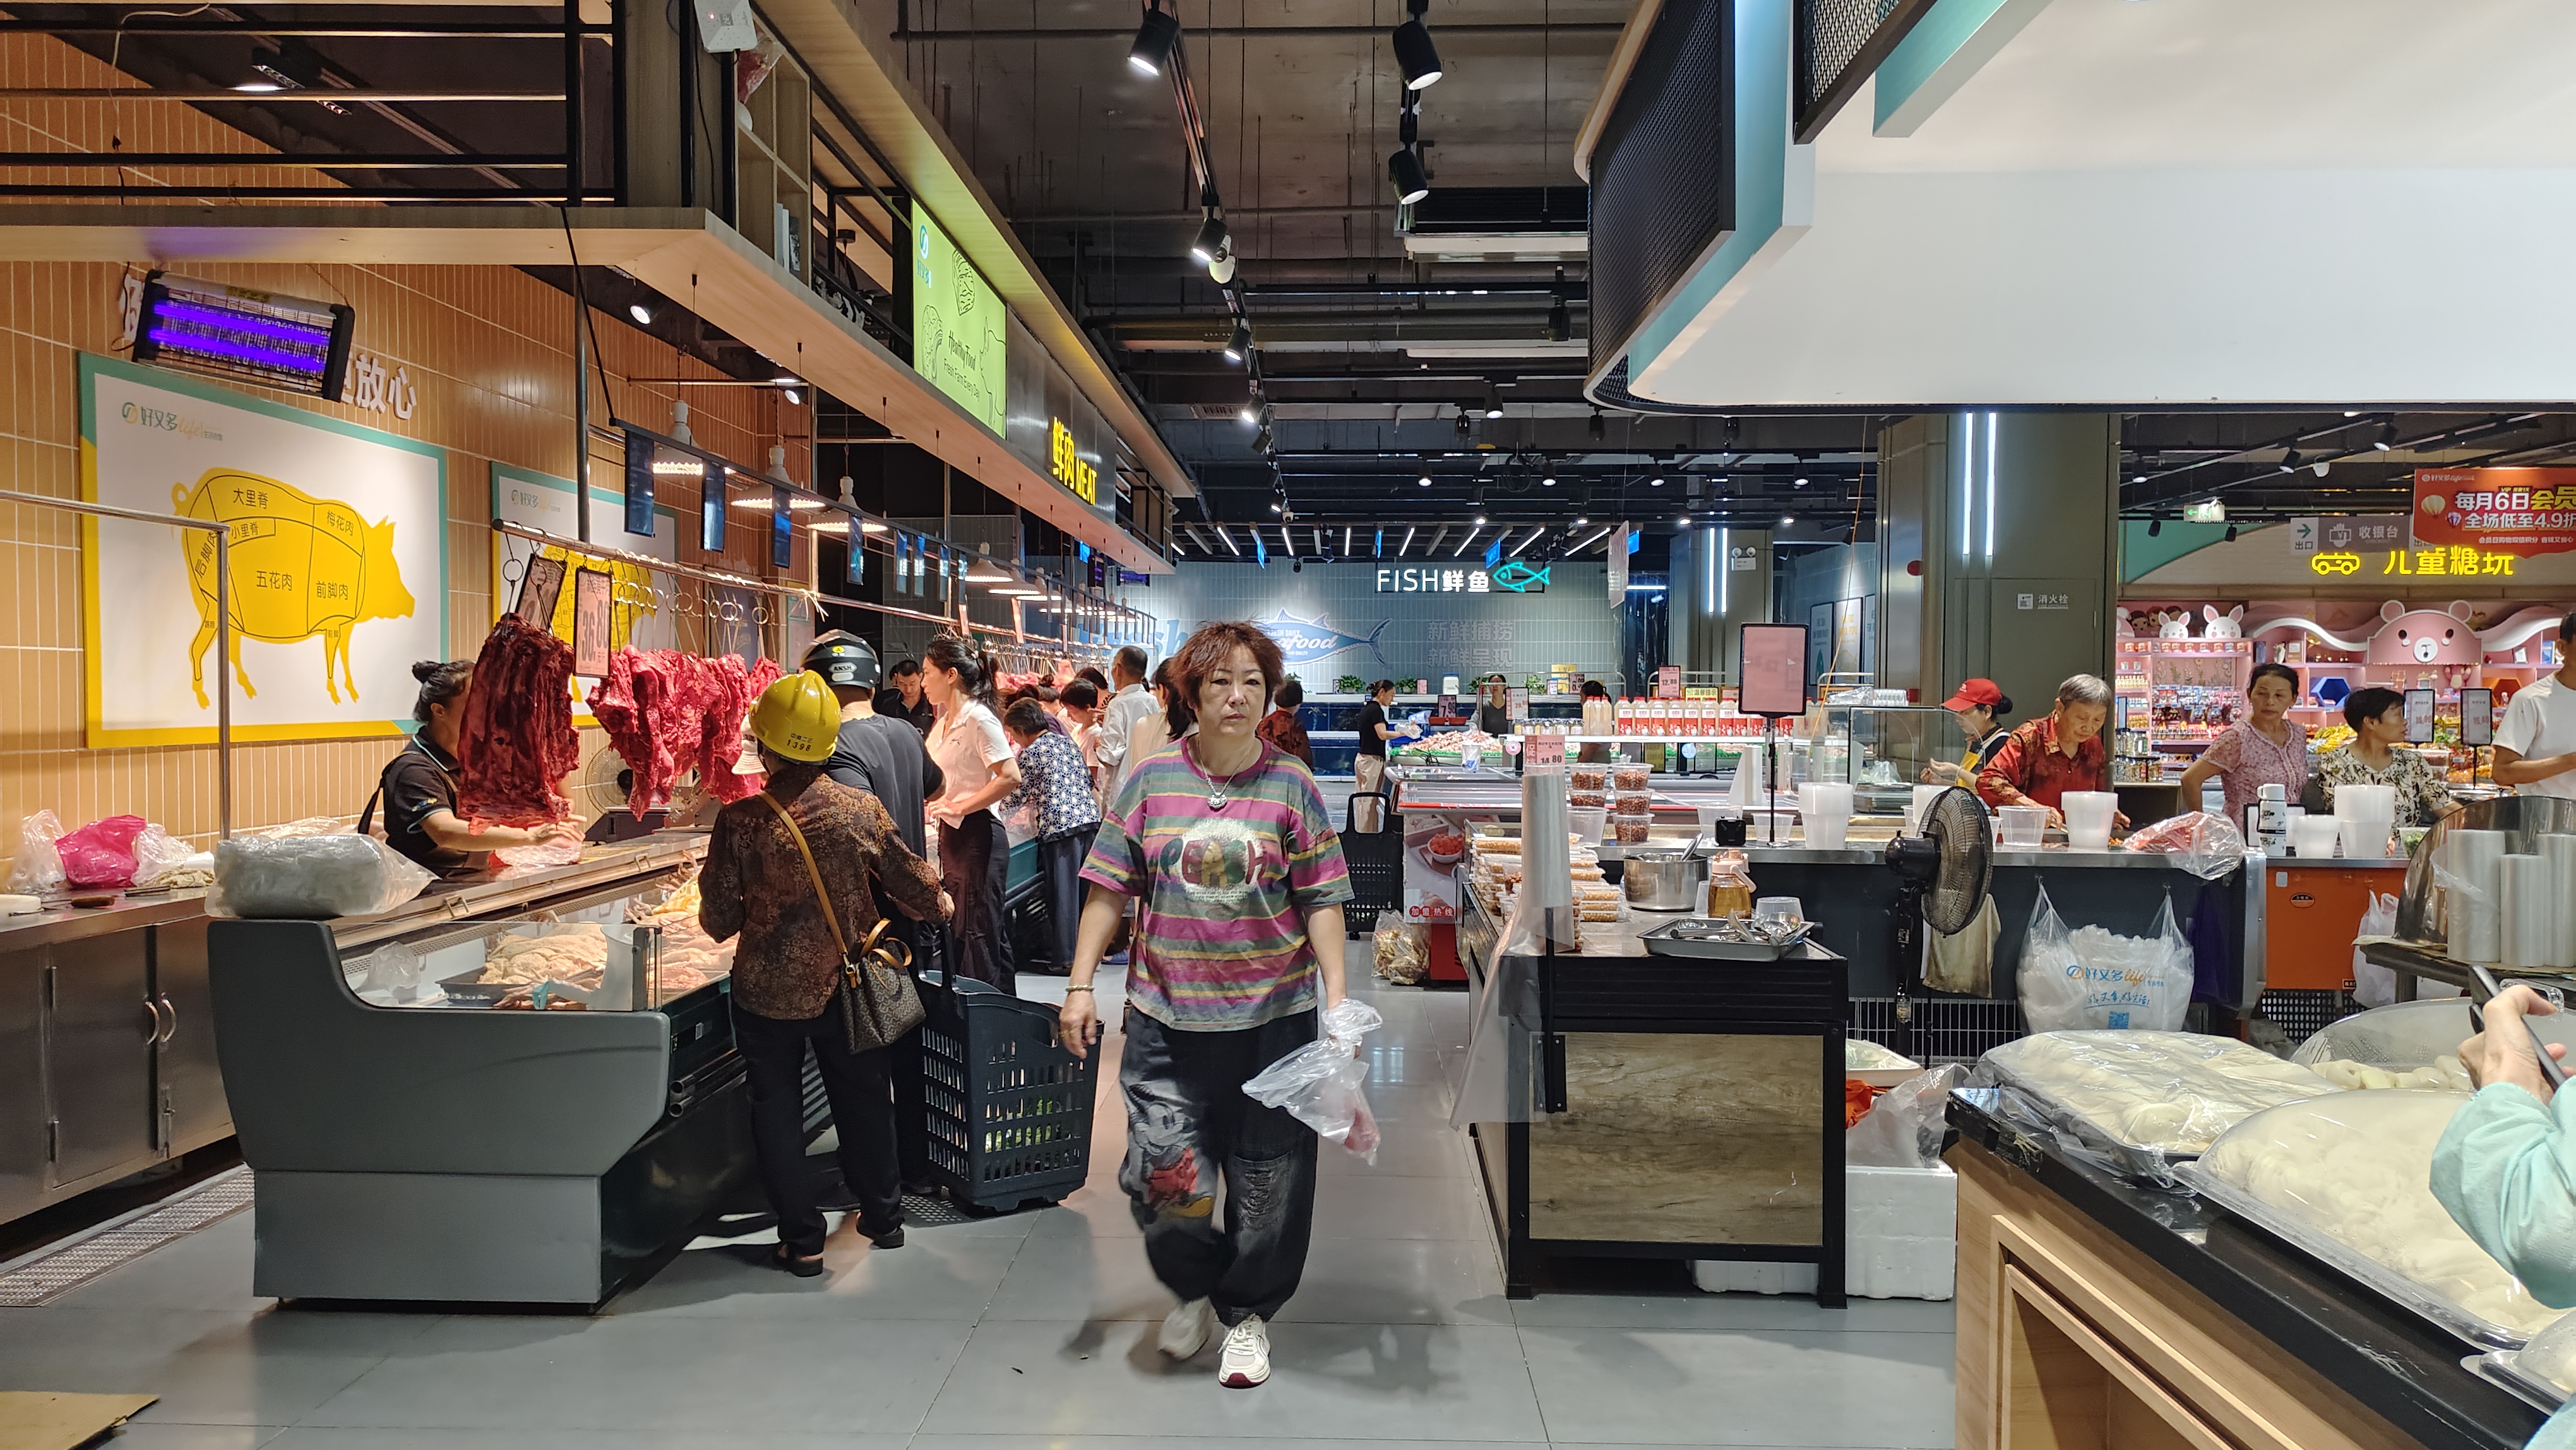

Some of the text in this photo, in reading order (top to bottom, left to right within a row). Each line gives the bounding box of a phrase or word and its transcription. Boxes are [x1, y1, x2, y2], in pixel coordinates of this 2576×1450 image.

[948, 330, 976, 371] Healthy Food
[944, 357, 955, 378] Fresh
[963, 375, 974, 397] Every
[140, 405, 178, 431] 好又多
[1052, 416, 1098, 505] 鲜肉 MEAT
[233, 488, 268, 509] 大里脊
[231, 522, 259, 539] 小里脊
[326, 510, 354, 537] 梅花肉
[2464, 512, 2576, 529] 全场低至4.9折
[2359, 525, 2399, 539] 收银台
[195, 531, 217, 579] 后脚肉
[2294, 541, 2313, 550] 出口
[256, 570, 292, 592] 五花肉
[316, 580, 349, 601] 前脚肉
[1378, 568, 1490, 592] FISH 鲜鱼
[2038, 594, 2069, 604] 消火栓
[1428, 620, 1514, 642] 新鲜捕捞
[1427, 647, 1514, 669] 新鲜呈现
[787, 740, 811, 752] 1398
[1411, 907, 1453, 917] 加盟热线
[2085, 967, 2123, 982] 好又多
[2124, 968, 2145, 986] life
